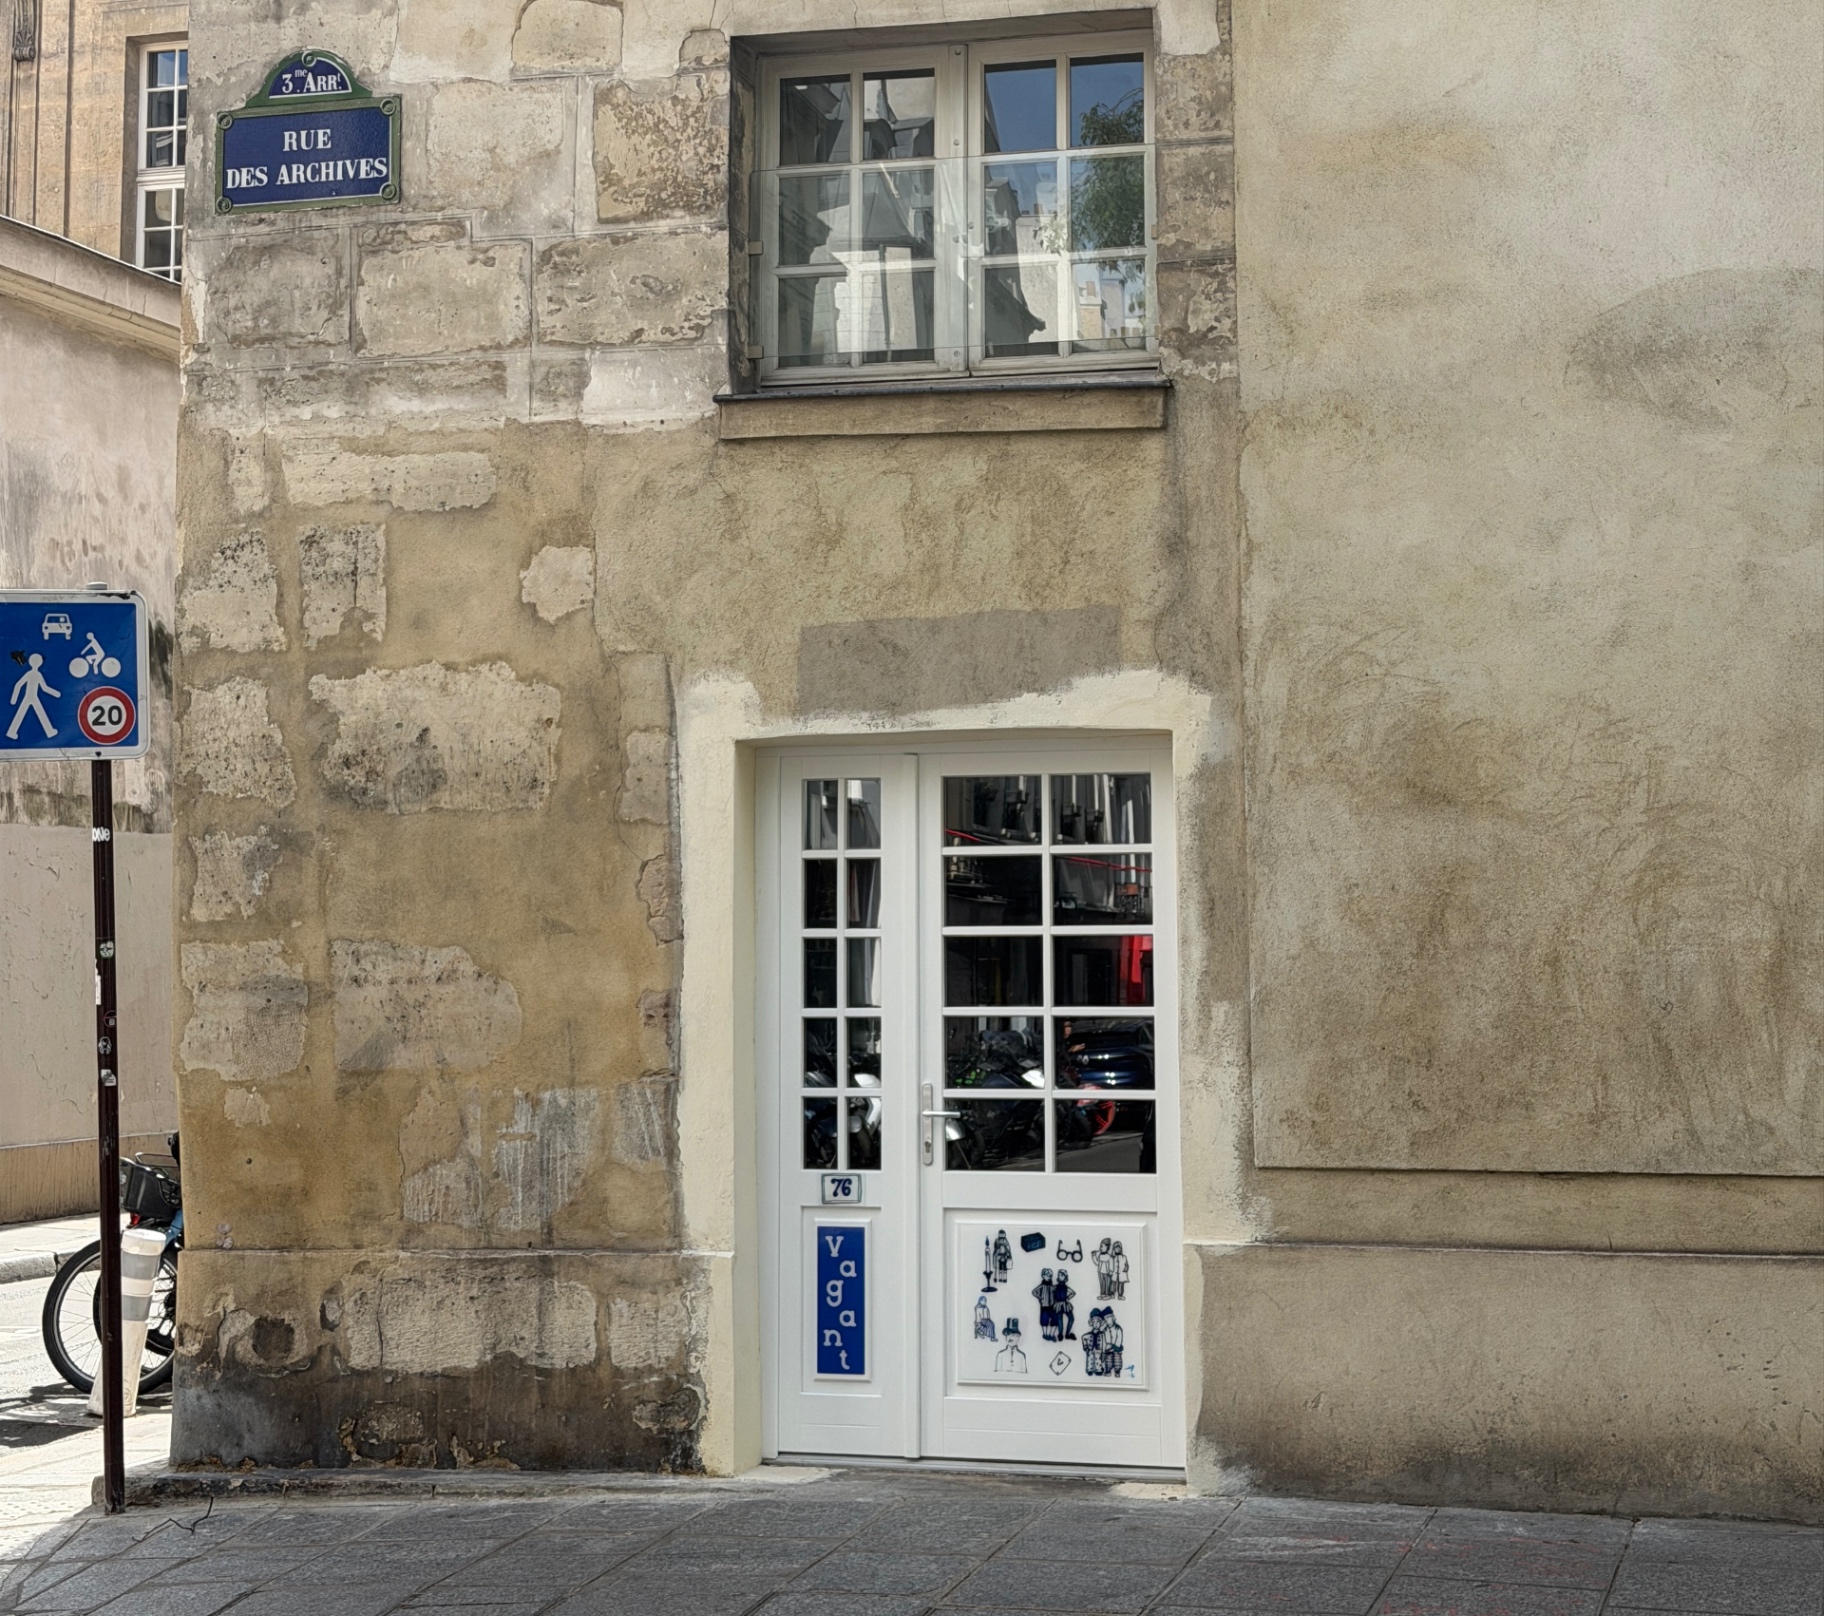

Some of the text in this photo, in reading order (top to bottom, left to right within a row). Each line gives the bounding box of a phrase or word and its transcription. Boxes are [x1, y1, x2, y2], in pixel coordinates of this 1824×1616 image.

[282, 128, 332, 152] RUE
[225, 156, 388, 189] DES ARCHIVES
[91, 705, 123, 727] 20
[830, 1177, 853, 1198] 76
